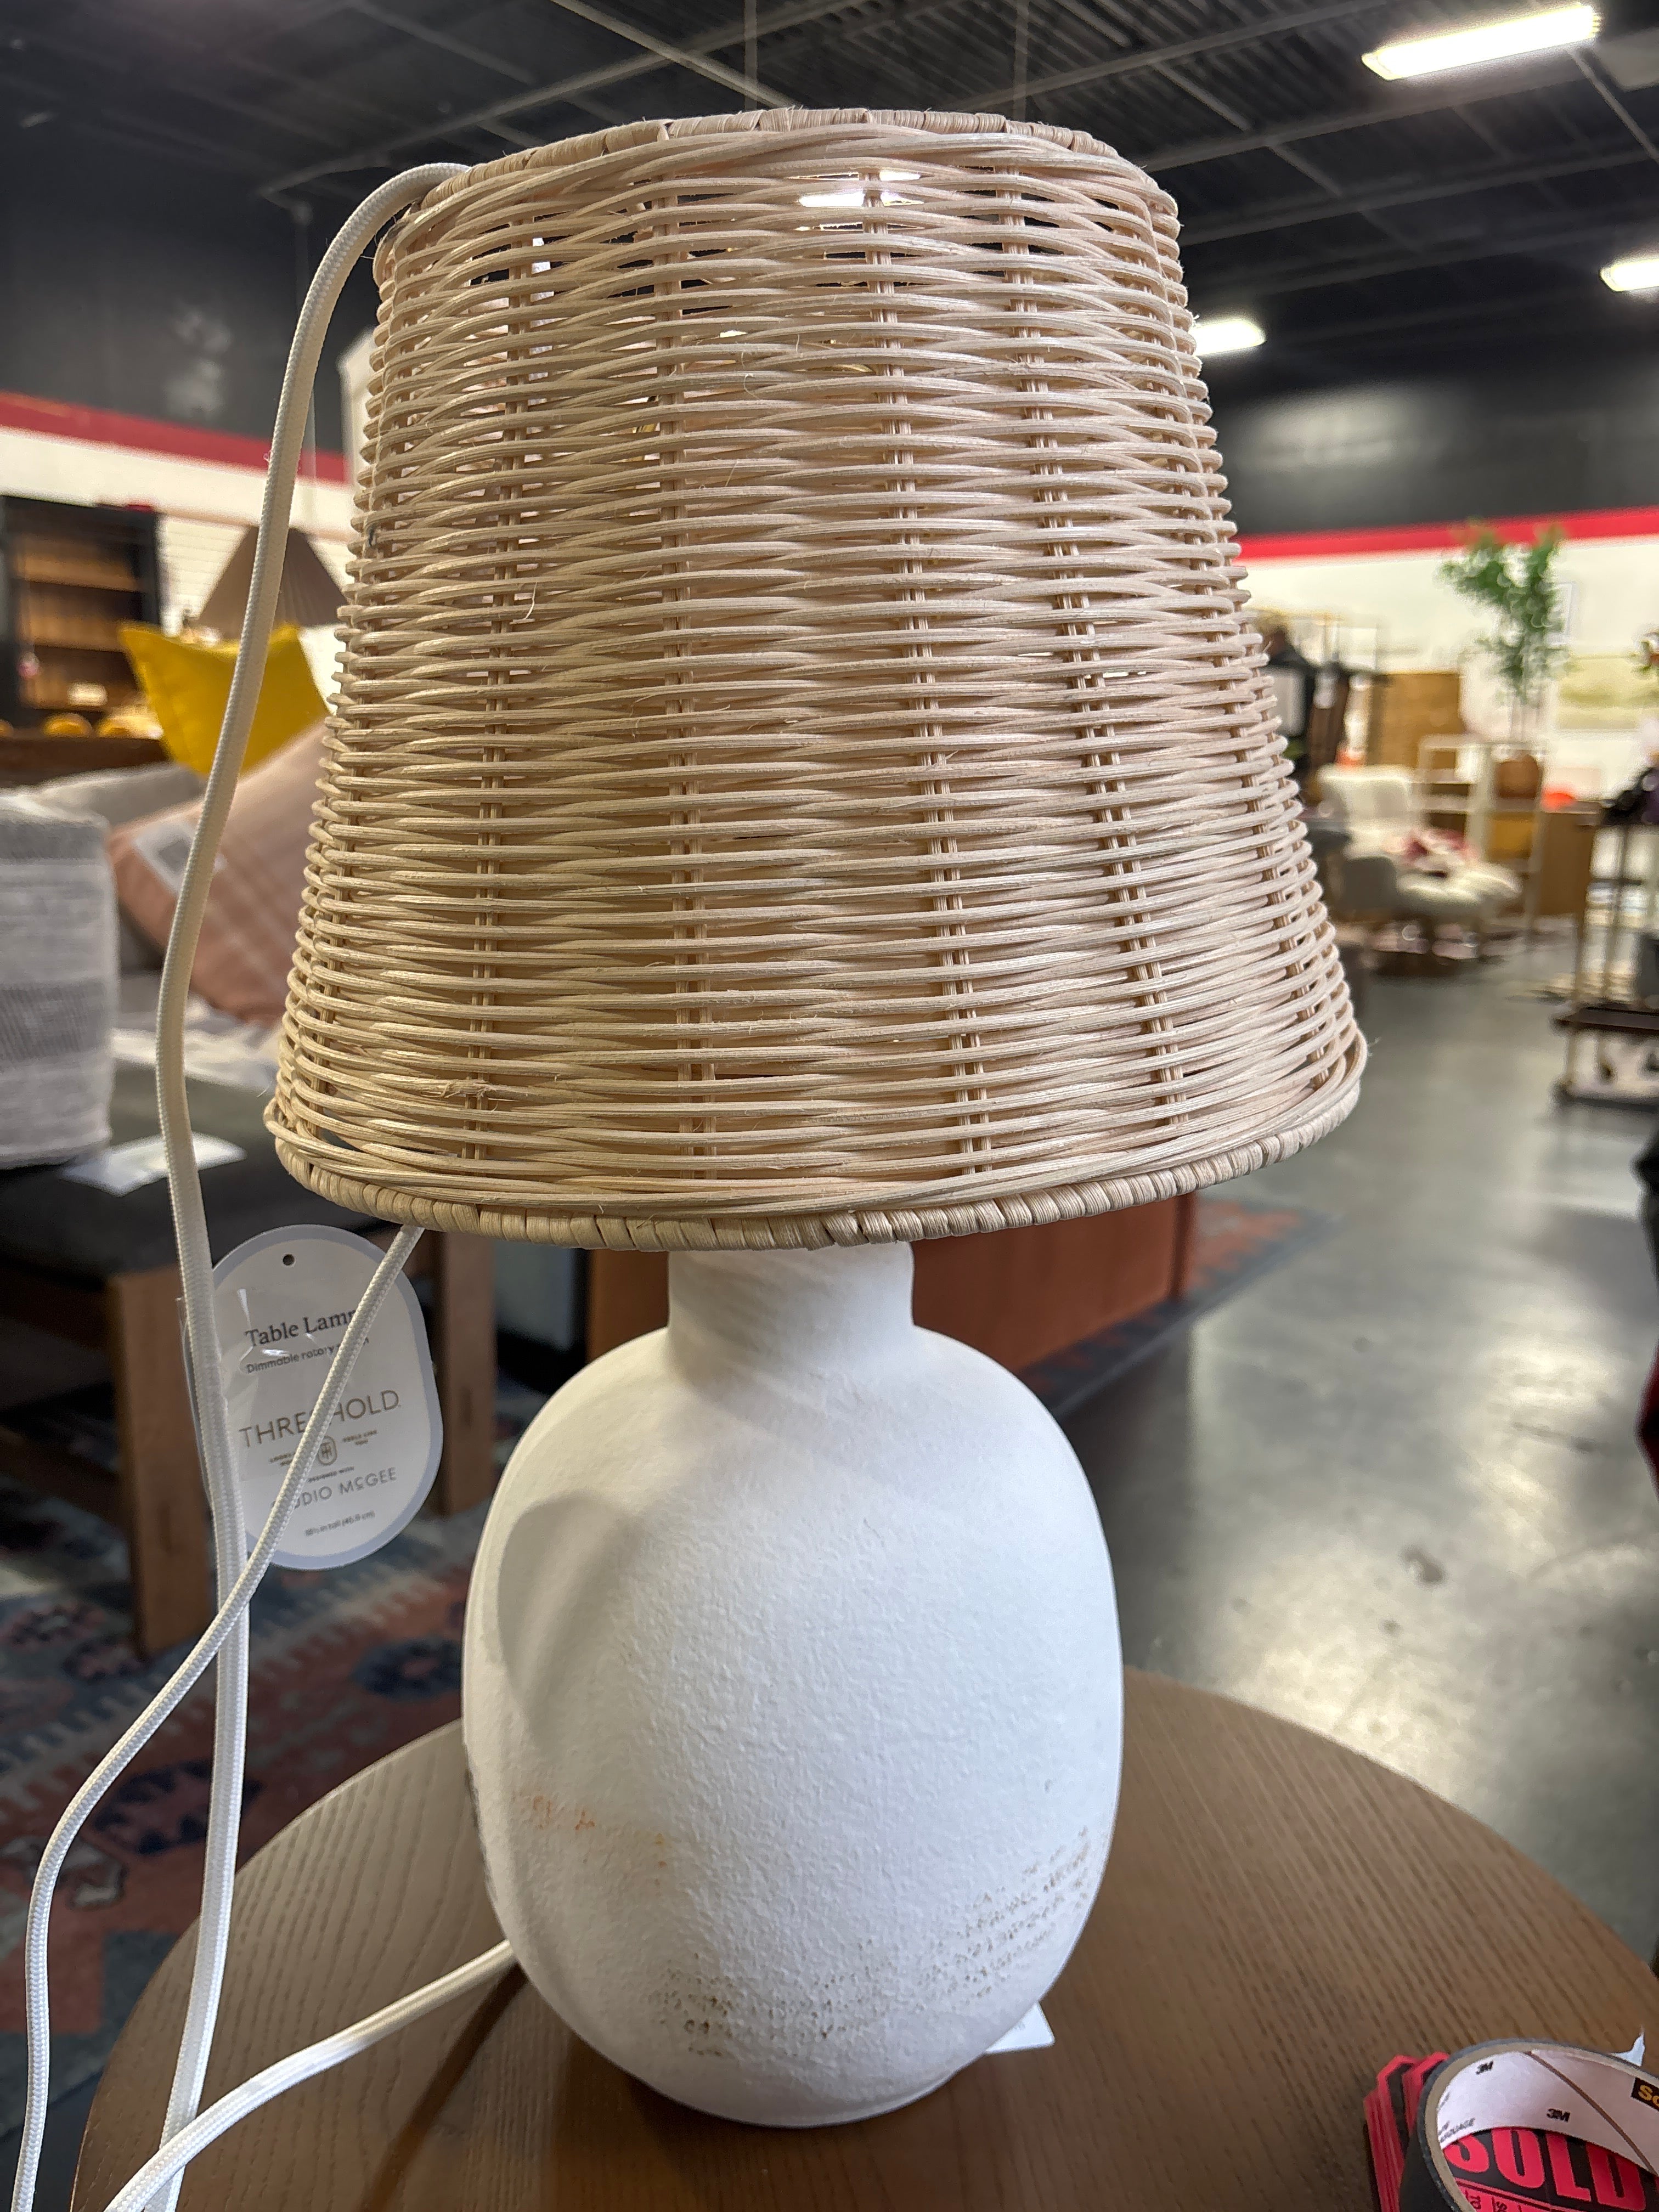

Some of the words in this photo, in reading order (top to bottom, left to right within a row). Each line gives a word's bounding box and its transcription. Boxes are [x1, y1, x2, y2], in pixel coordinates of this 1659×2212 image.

[244, 1322, 300, 1347] Table
[246, 1353, 300, 1374] Dimmable
[239, 1390, 400, 1448] THREHOLD
[1476, 2060, 1494, 2075] 3M
[1546, 2108, 1571, 2123] 3M
